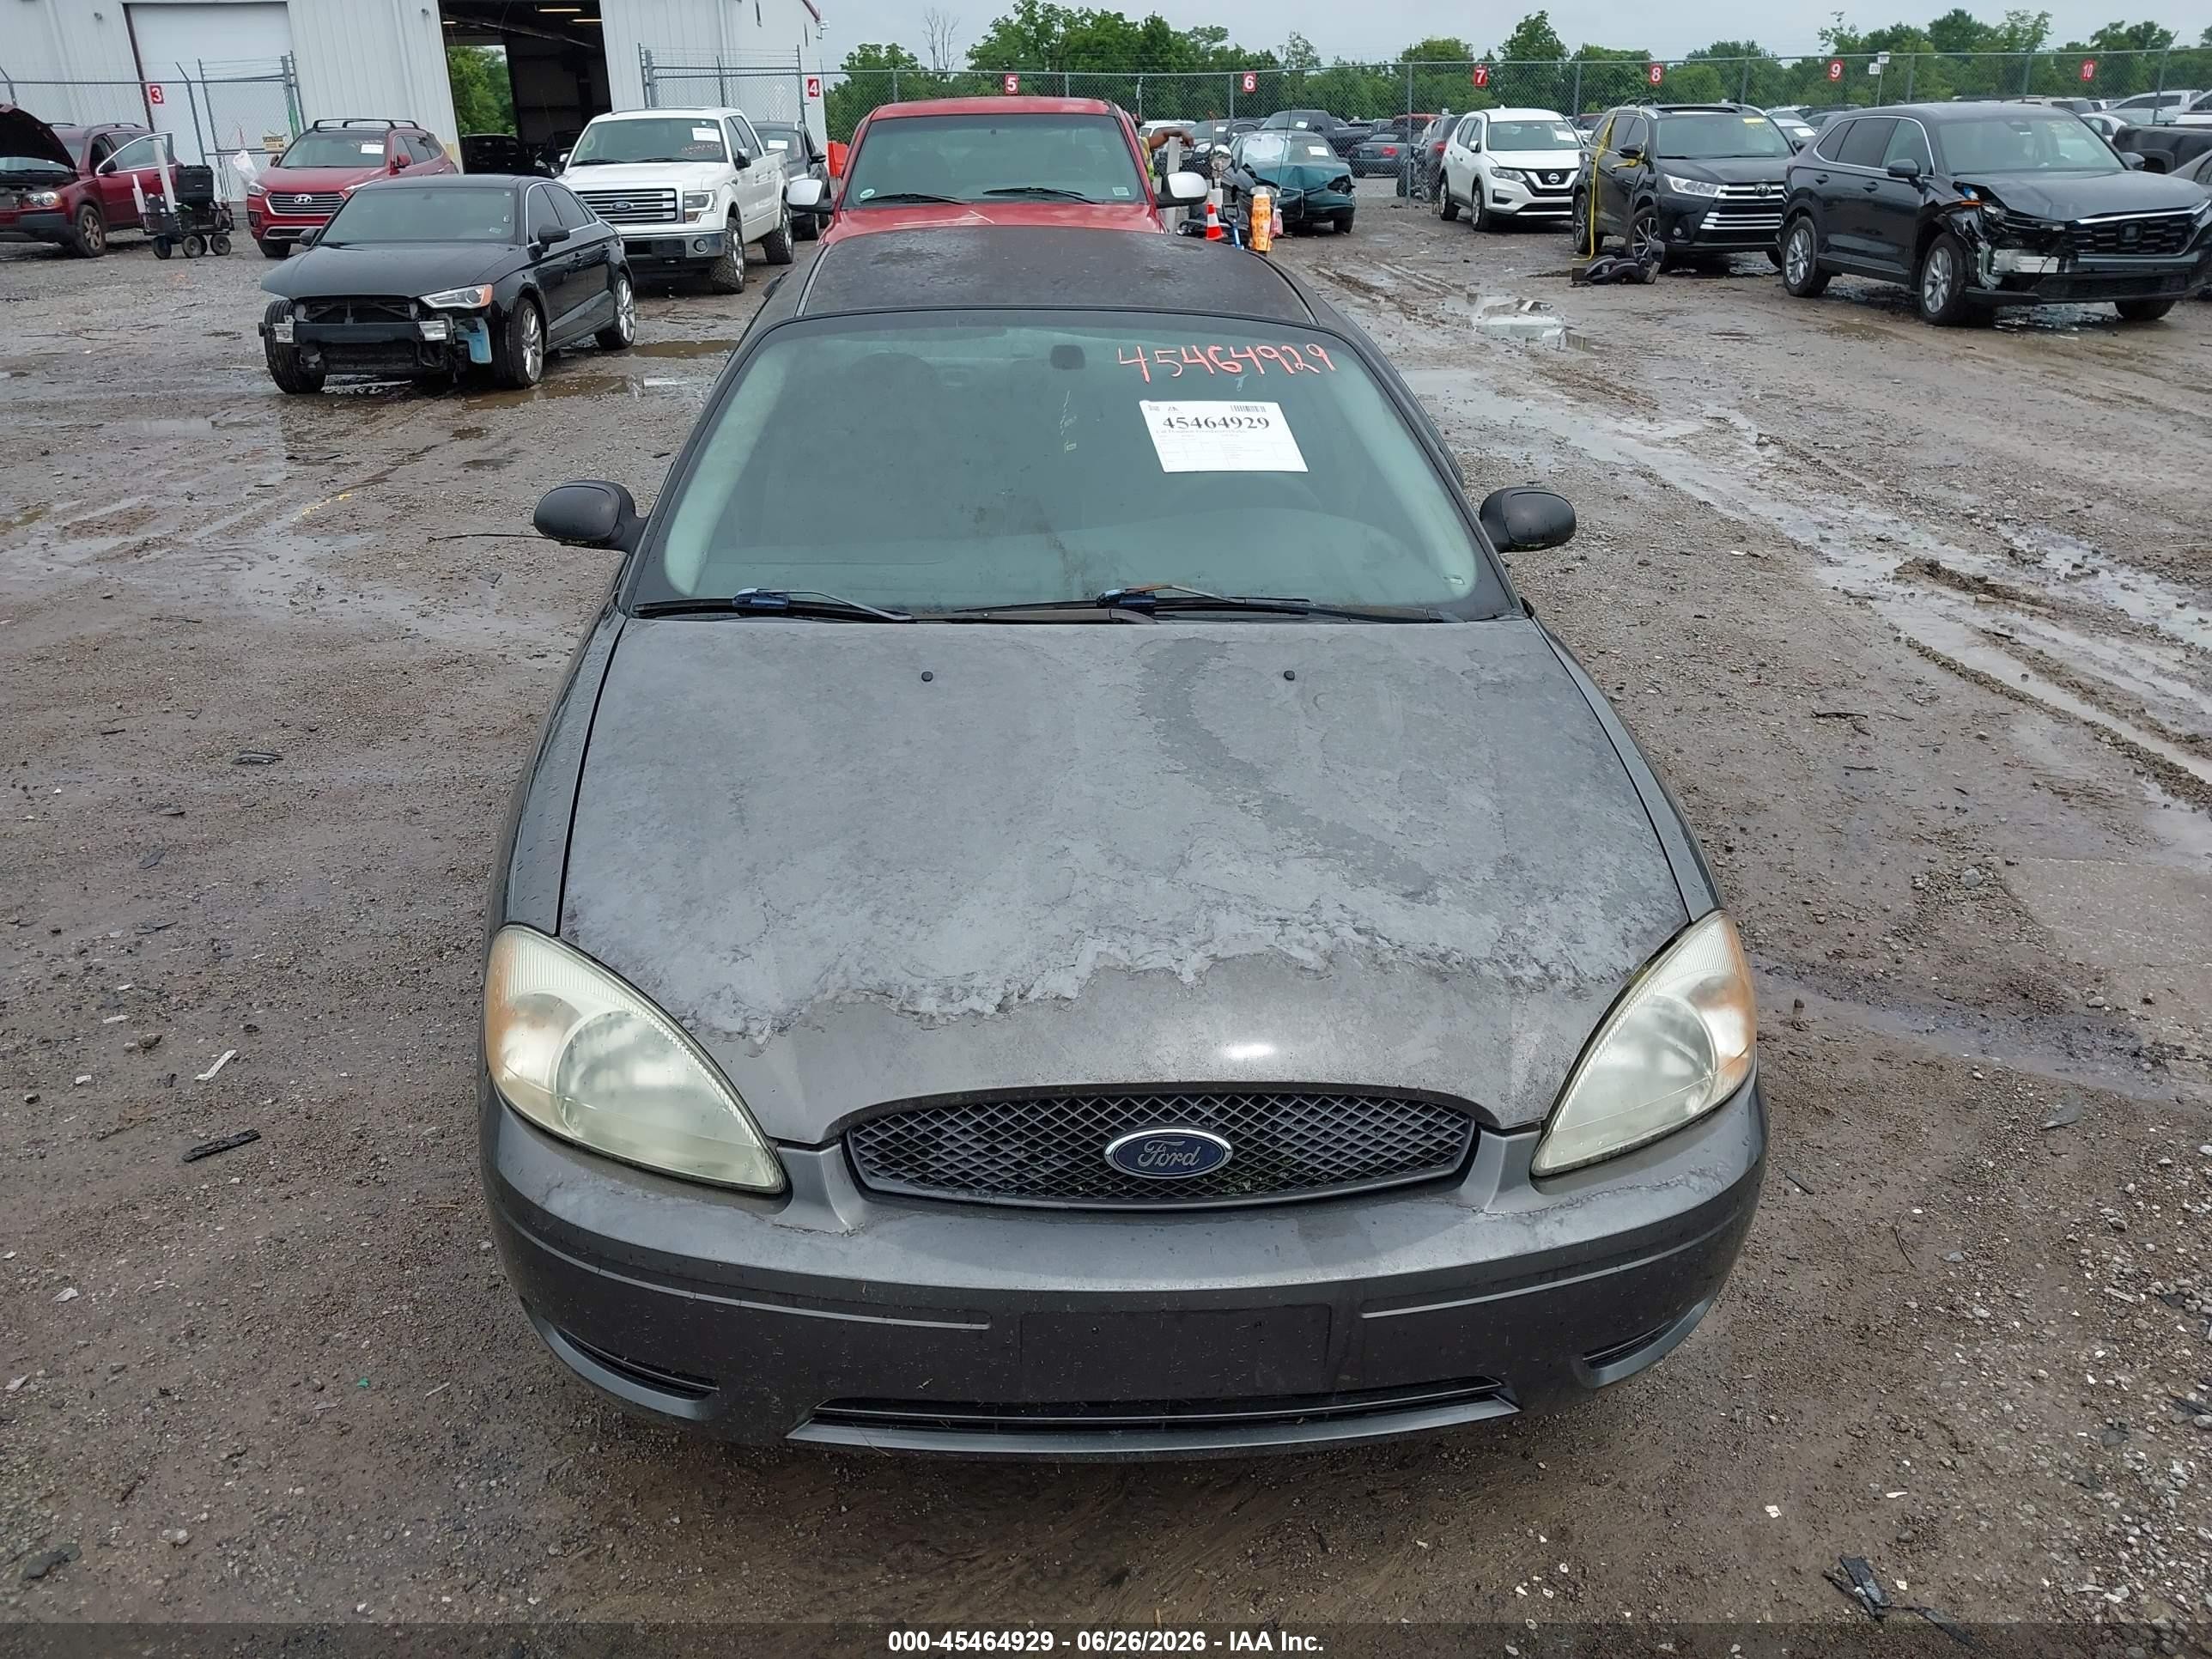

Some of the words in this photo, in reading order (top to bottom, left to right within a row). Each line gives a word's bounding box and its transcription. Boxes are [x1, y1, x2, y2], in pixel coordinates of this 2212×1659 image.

[1476, 69, 1486, 84] 7
[1651, 67, 1662, 82] 8
[1831, 63, 1841, 78] 9
[2082, 64, 2094, 77] 10
[809, 80, 819, 95] 4
[1006, 76, 1017, 92] 5
[1244, 75, 1255, 90] 6
[151, 87, 162, 102] 3
[1117, 343, 1337, 384] 45464929
[1163, 416, 1270, 429] 45464929
[1137, 1139, 1202, 1168] Ford
